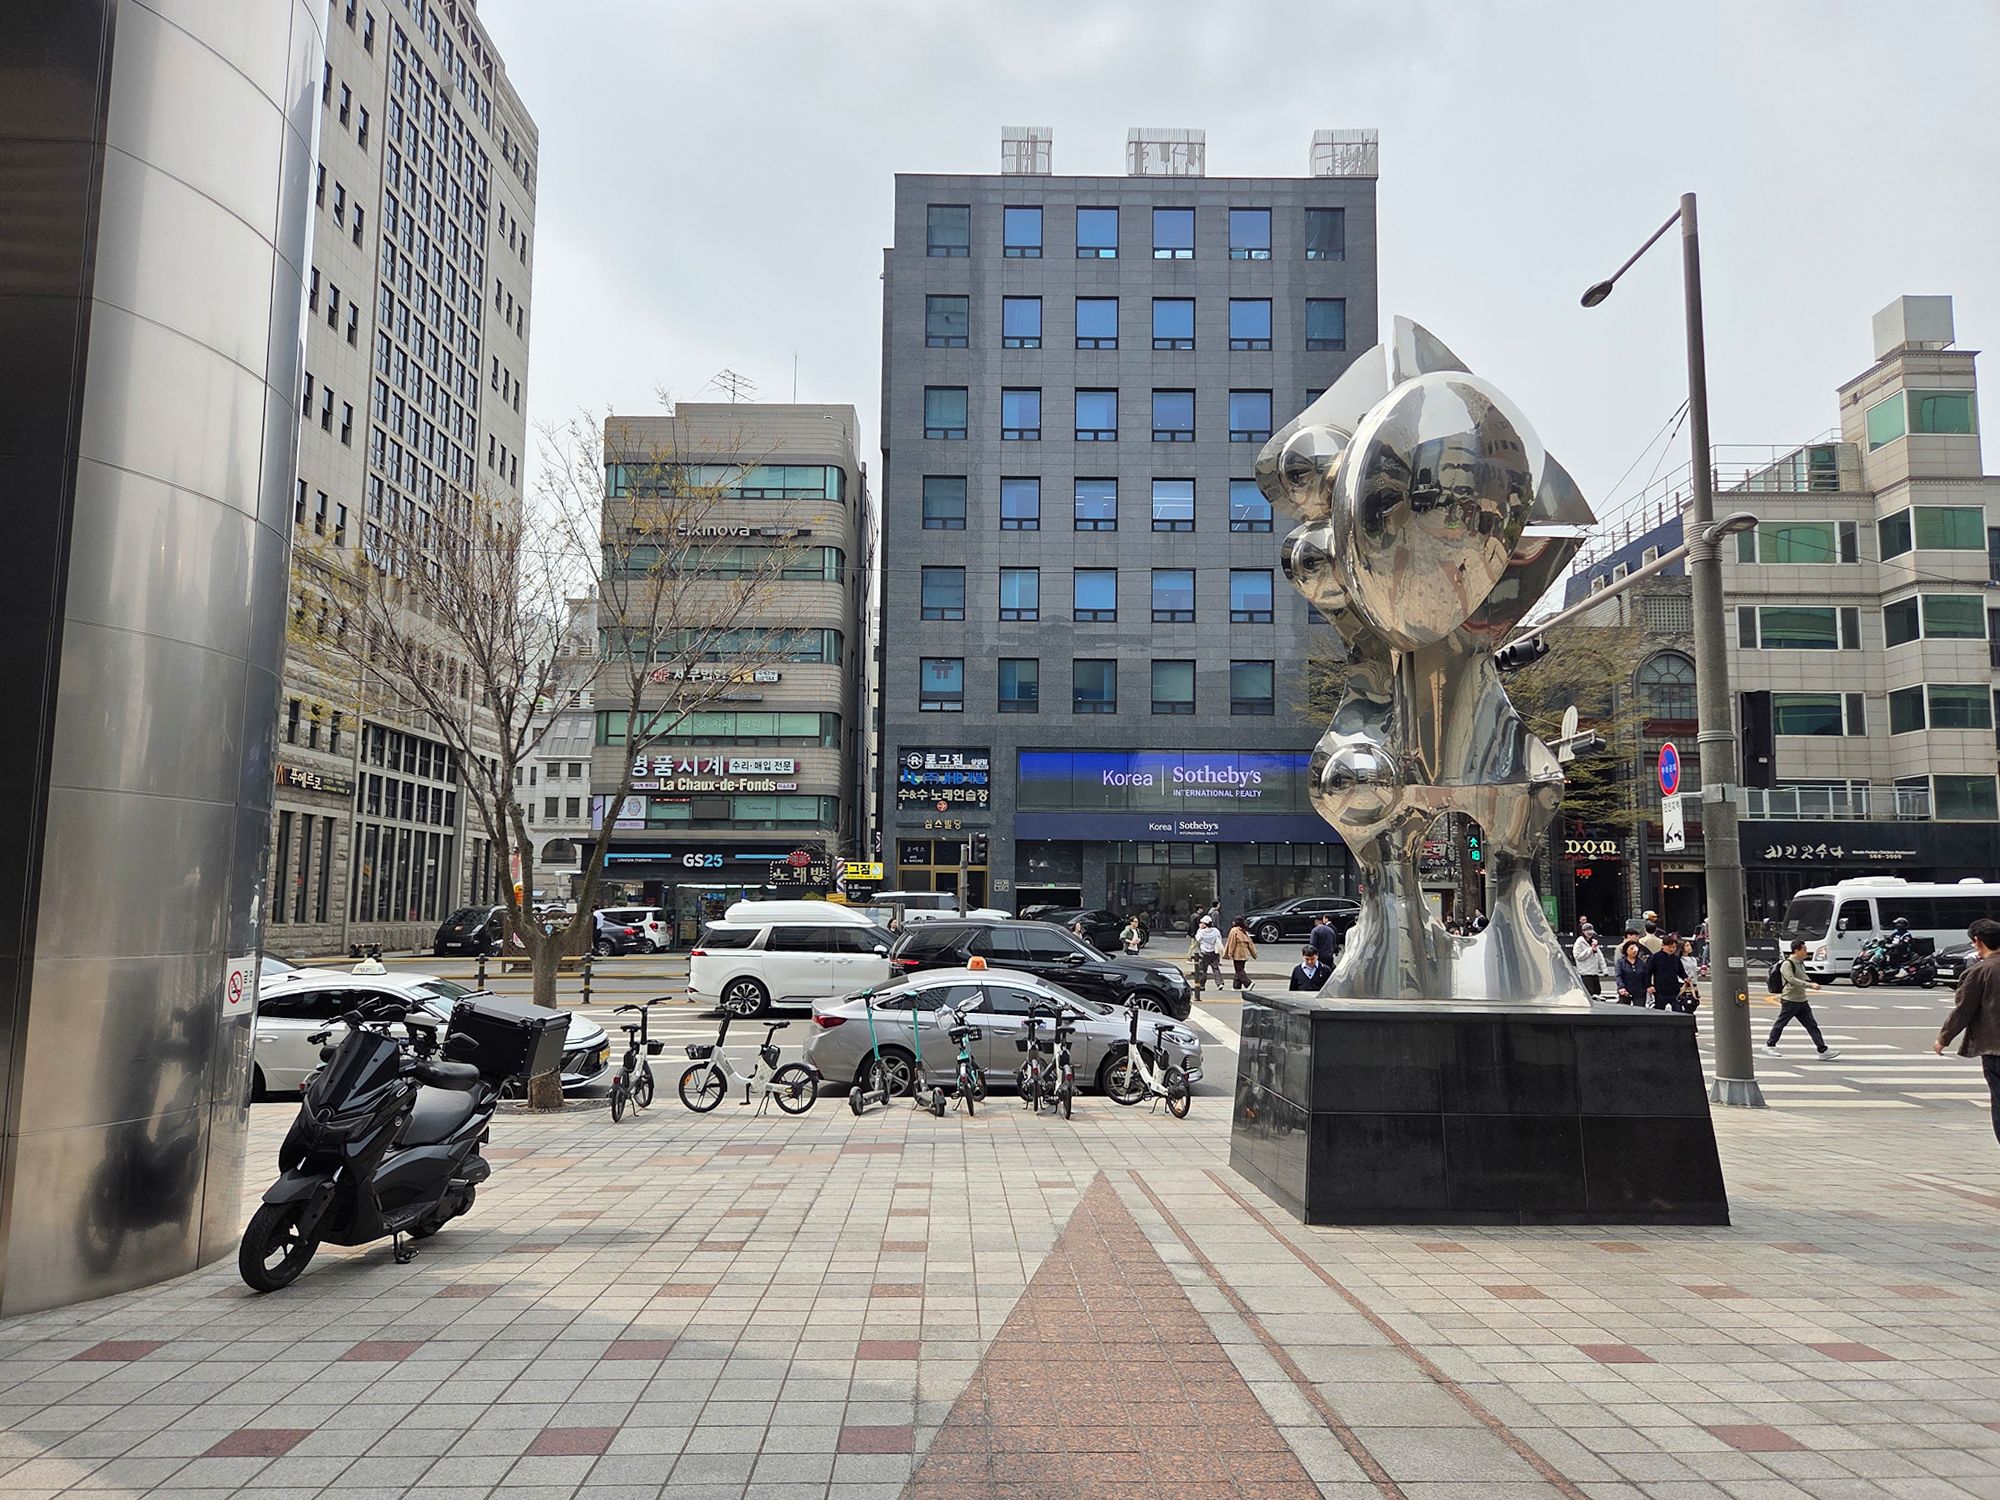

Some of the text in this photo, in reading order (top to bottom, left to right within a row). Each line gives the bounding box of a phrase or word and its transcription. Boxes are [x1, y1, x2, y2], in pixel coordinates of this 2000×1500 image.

[774, 760, 792, 771] 전문
[925, 753, 963, 766] 로그짐
[1102, 764, 1262, 788] Korea Sotheby's
[659, 777, 674, 791] La
[677, 777, 776, 792] Chaux-de-Fonds
[898, 788, 989, 802] 수&수 노래연습장
[1149, 820, 1219, 832] Korea Sotheby's
[682, 853, 724, 868] GS25
